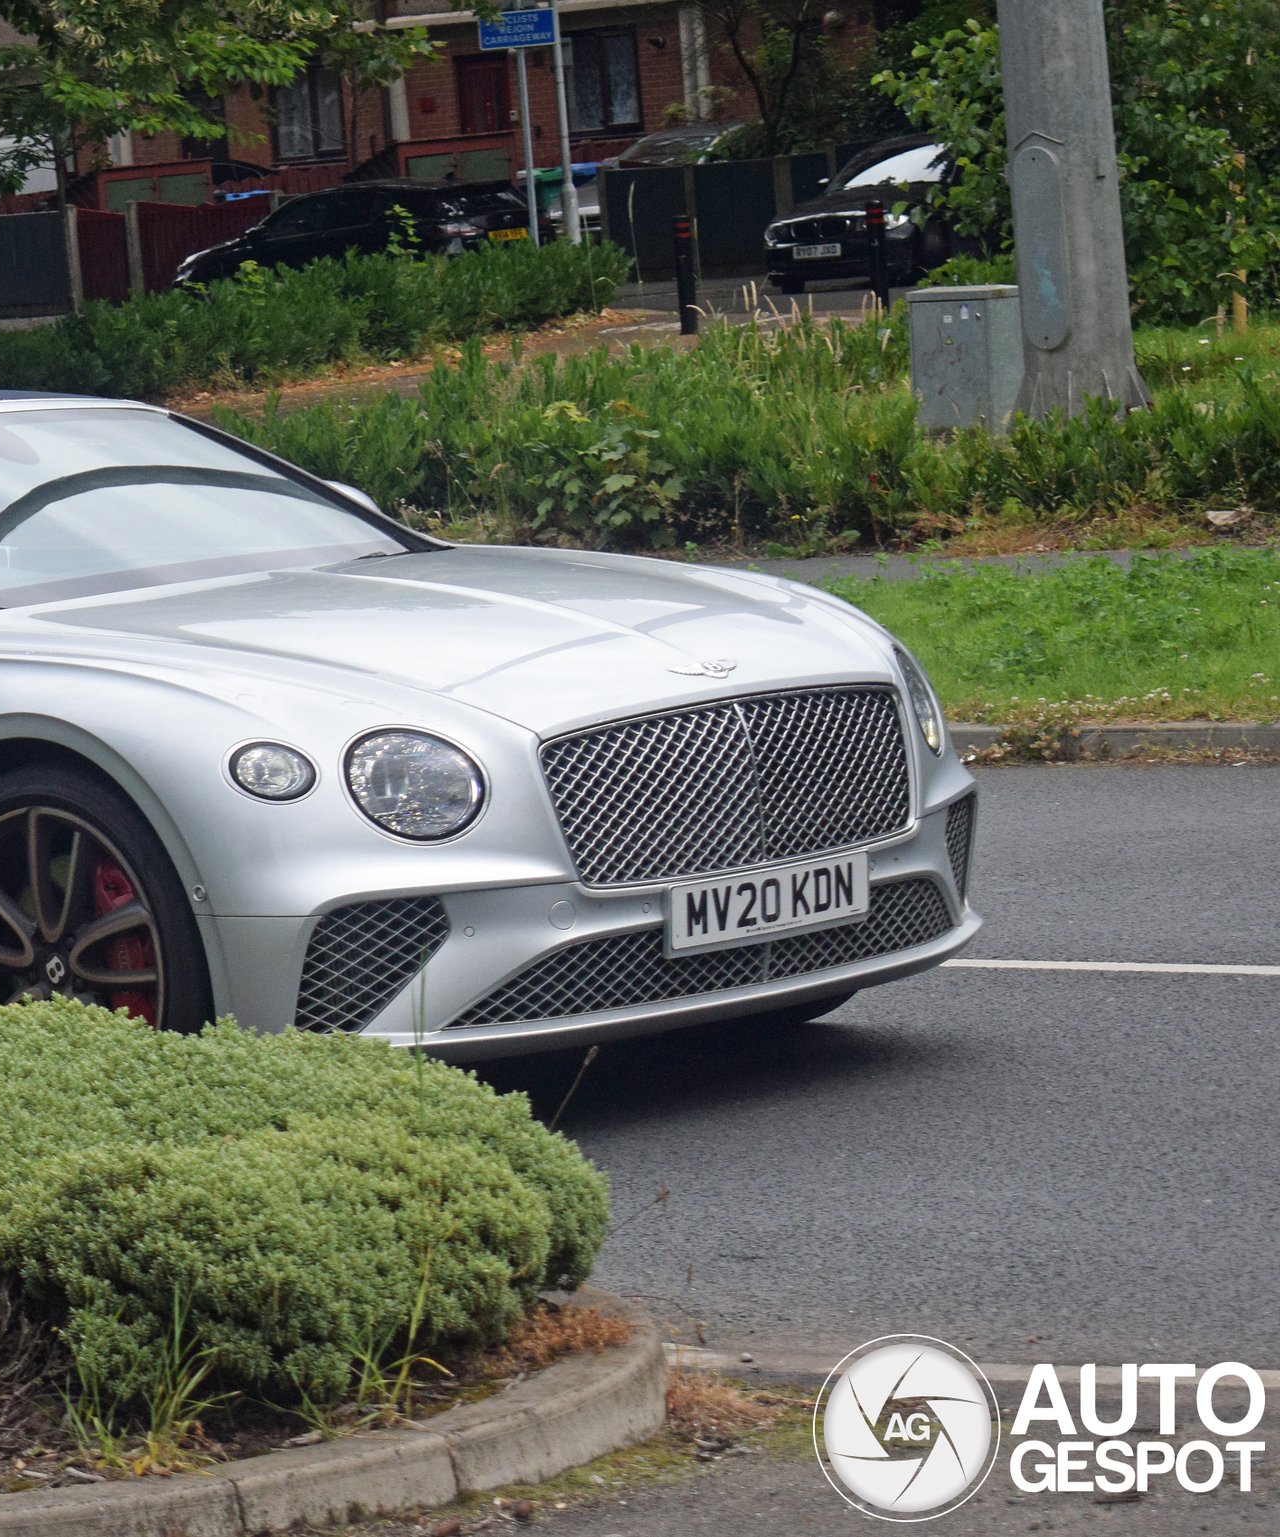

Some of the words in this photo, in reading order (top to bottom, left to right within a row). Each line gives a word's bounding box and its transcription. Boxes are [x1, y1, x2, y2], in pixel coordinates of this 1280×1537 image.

[483, 31, 552, 46] CARRIAGEWAY
[686, 877, 780, 937] MV20
[791, 861, 853, 918] KDN
